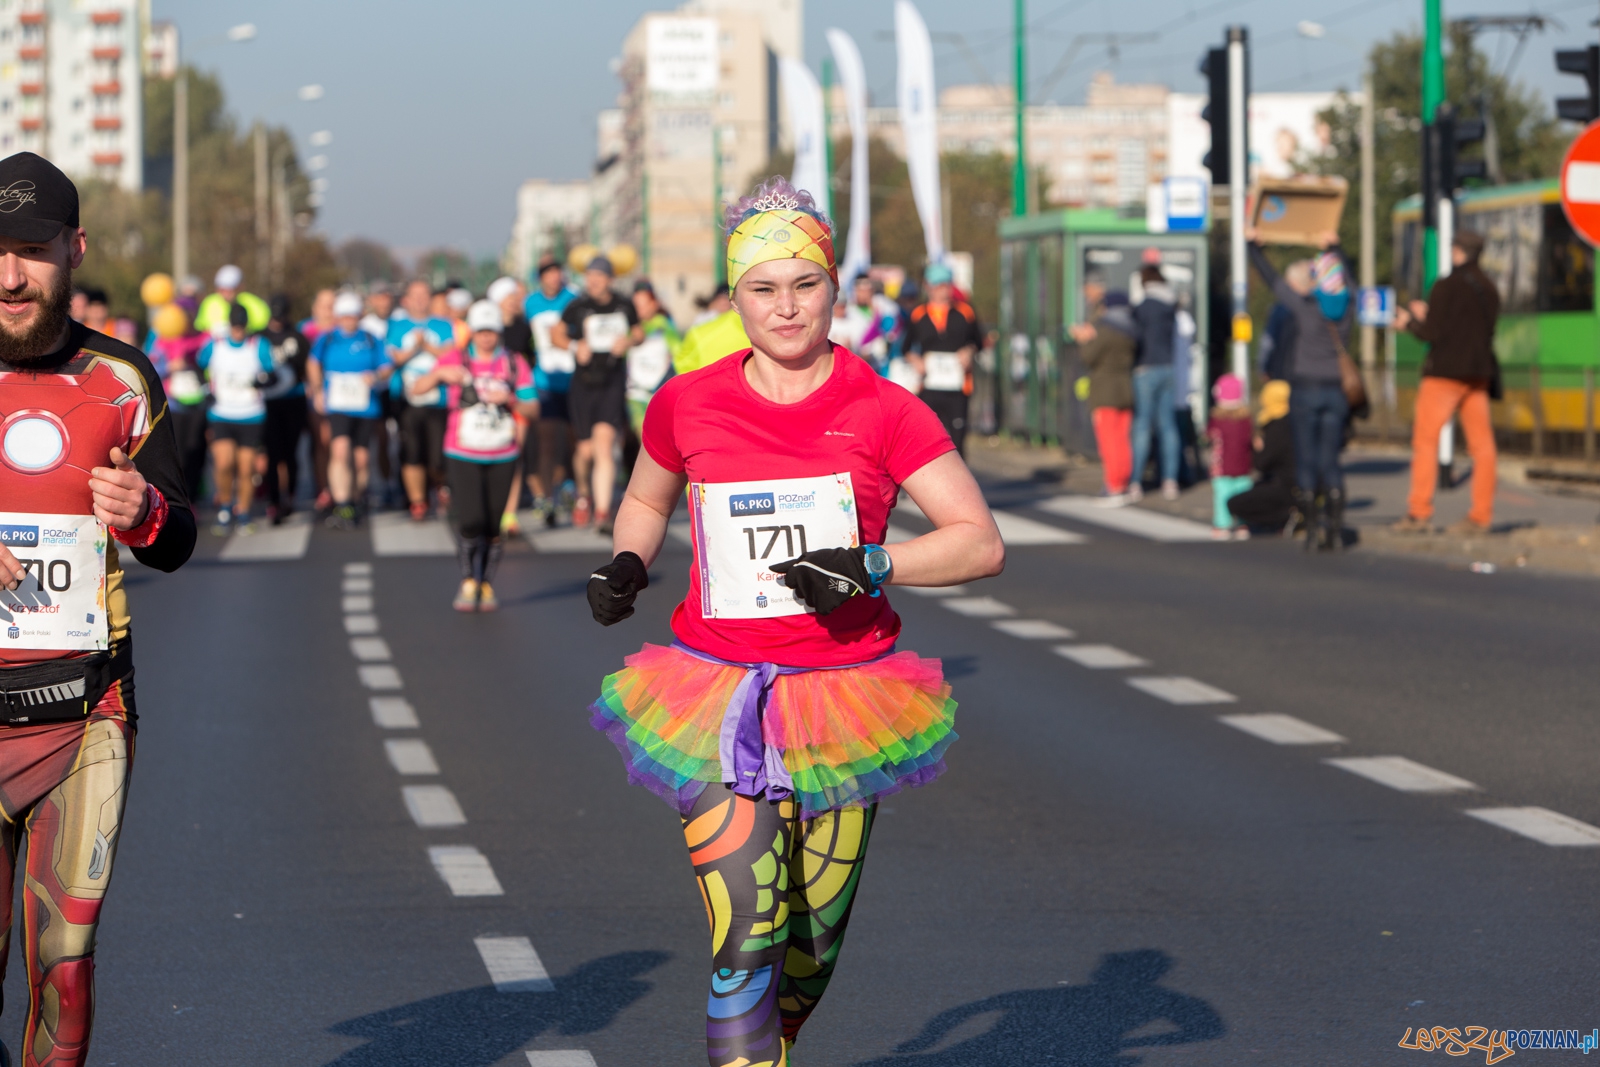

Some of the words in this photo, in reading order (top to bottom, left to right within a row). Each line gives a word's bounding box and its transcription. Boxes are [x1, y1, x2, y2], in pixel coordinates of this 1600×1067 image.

[732, 500, 748, 511] 16.
[749, 498, 772, 509] PKO
[779, 501, 815, 509] maraton
[12, 531, 35, 541] PKO
[742, 524, 808, 560] 1711
[3, 559, 71, 592] 710
[756, 571, 785, 582] Karo
[9, 603, 60, 614] Krzysztof
